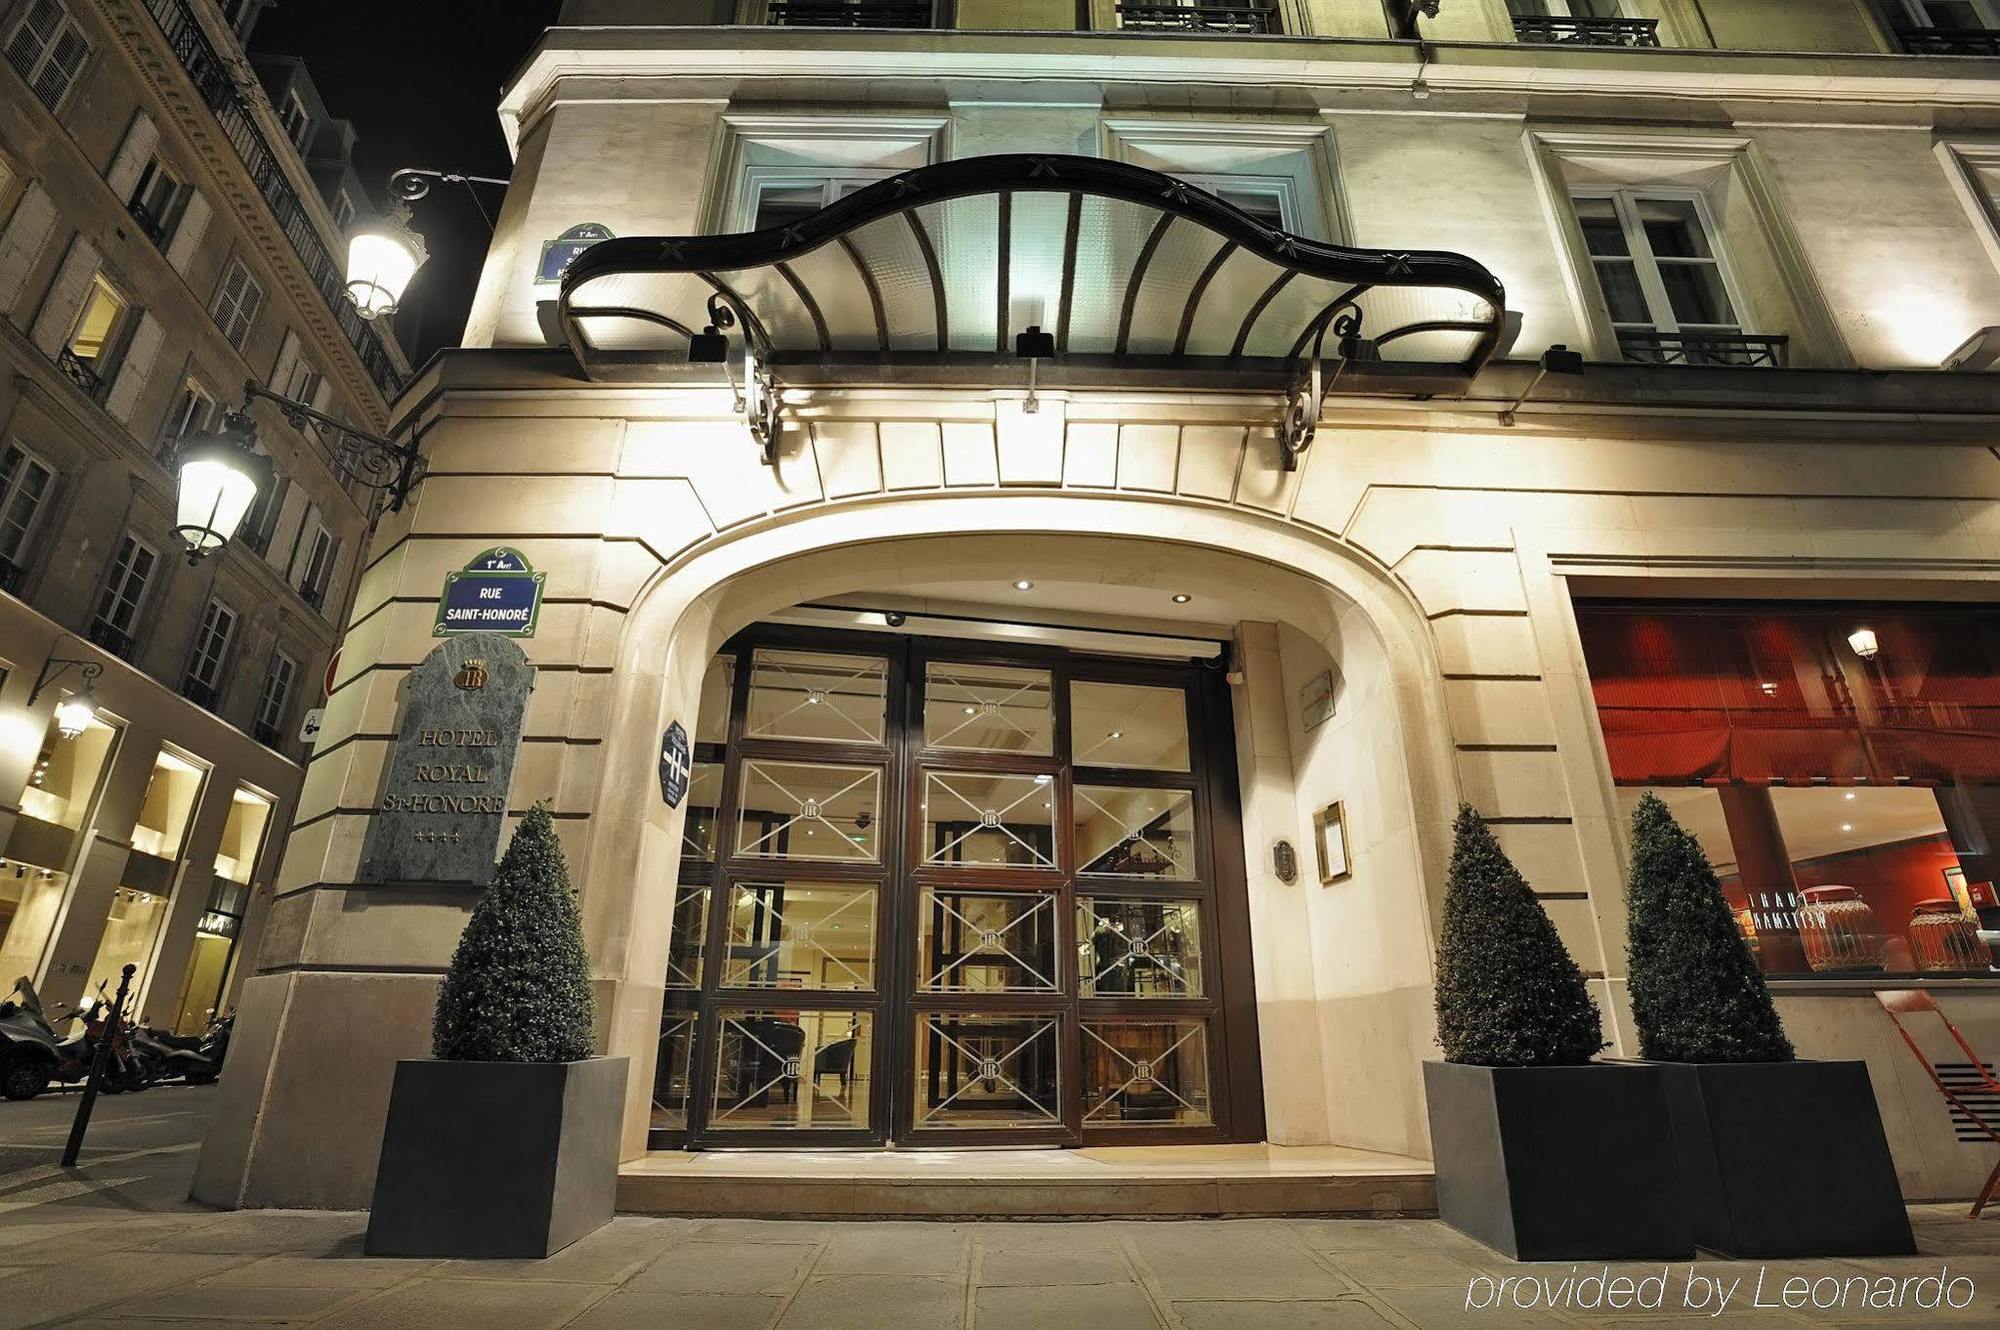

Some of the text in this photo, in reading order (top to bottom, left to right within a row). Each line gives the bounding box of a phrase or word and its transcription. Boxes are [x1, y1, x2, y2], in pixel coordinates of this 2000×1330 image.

[479, 587, 503, 599] RUE
[446, 607, 530, 621] SAINT-HONORÉ
[418, 728, 498, 747] HOTEL
[413, 765, 489, 783] ROYAL
